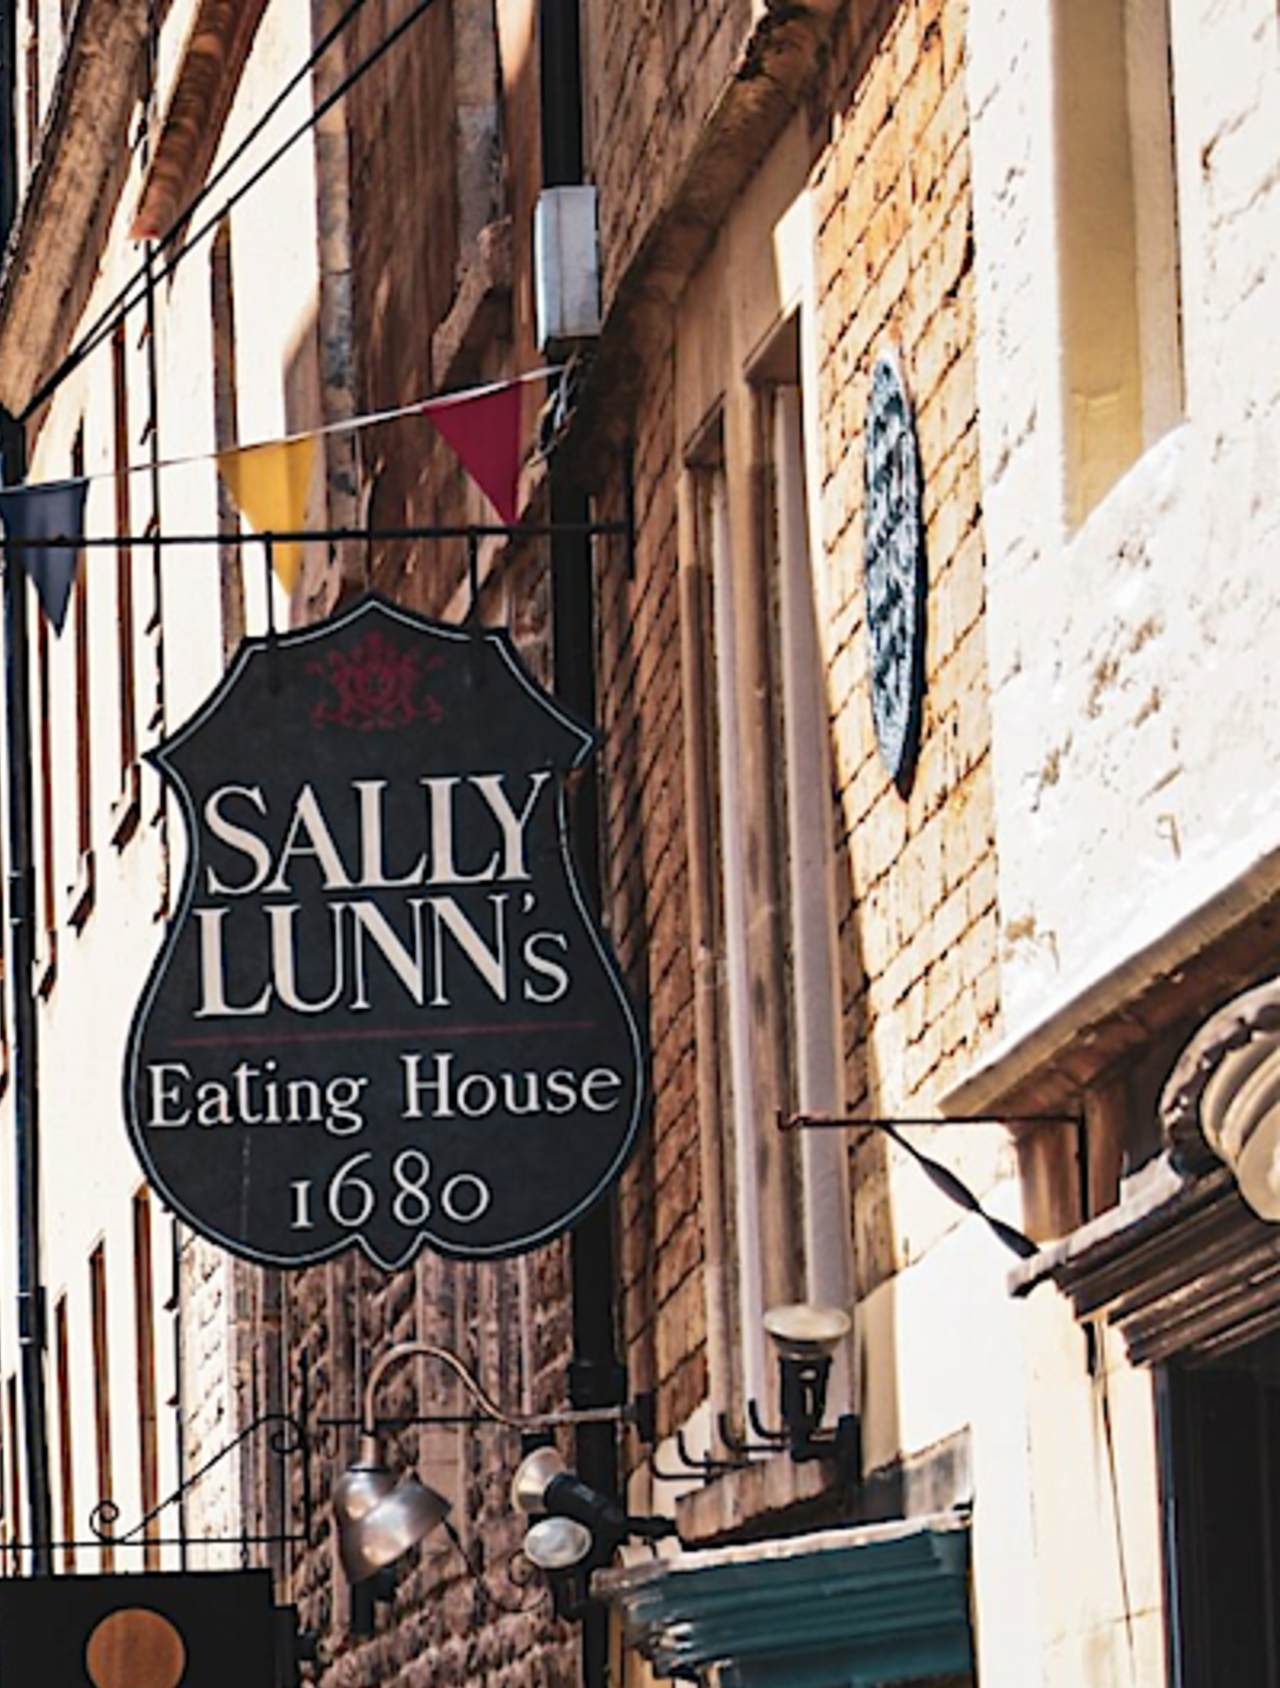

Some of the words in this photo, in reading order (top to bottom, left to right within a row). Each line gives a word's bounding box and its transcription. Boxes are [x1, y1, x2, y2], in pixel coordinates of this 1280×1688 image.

[203, 771, 551, 896] SALLY
[146, 1060, 368, 1136] Eating
[401, 1053, 622, 1119] House
[290, 1149, 491, 1230] 1680
